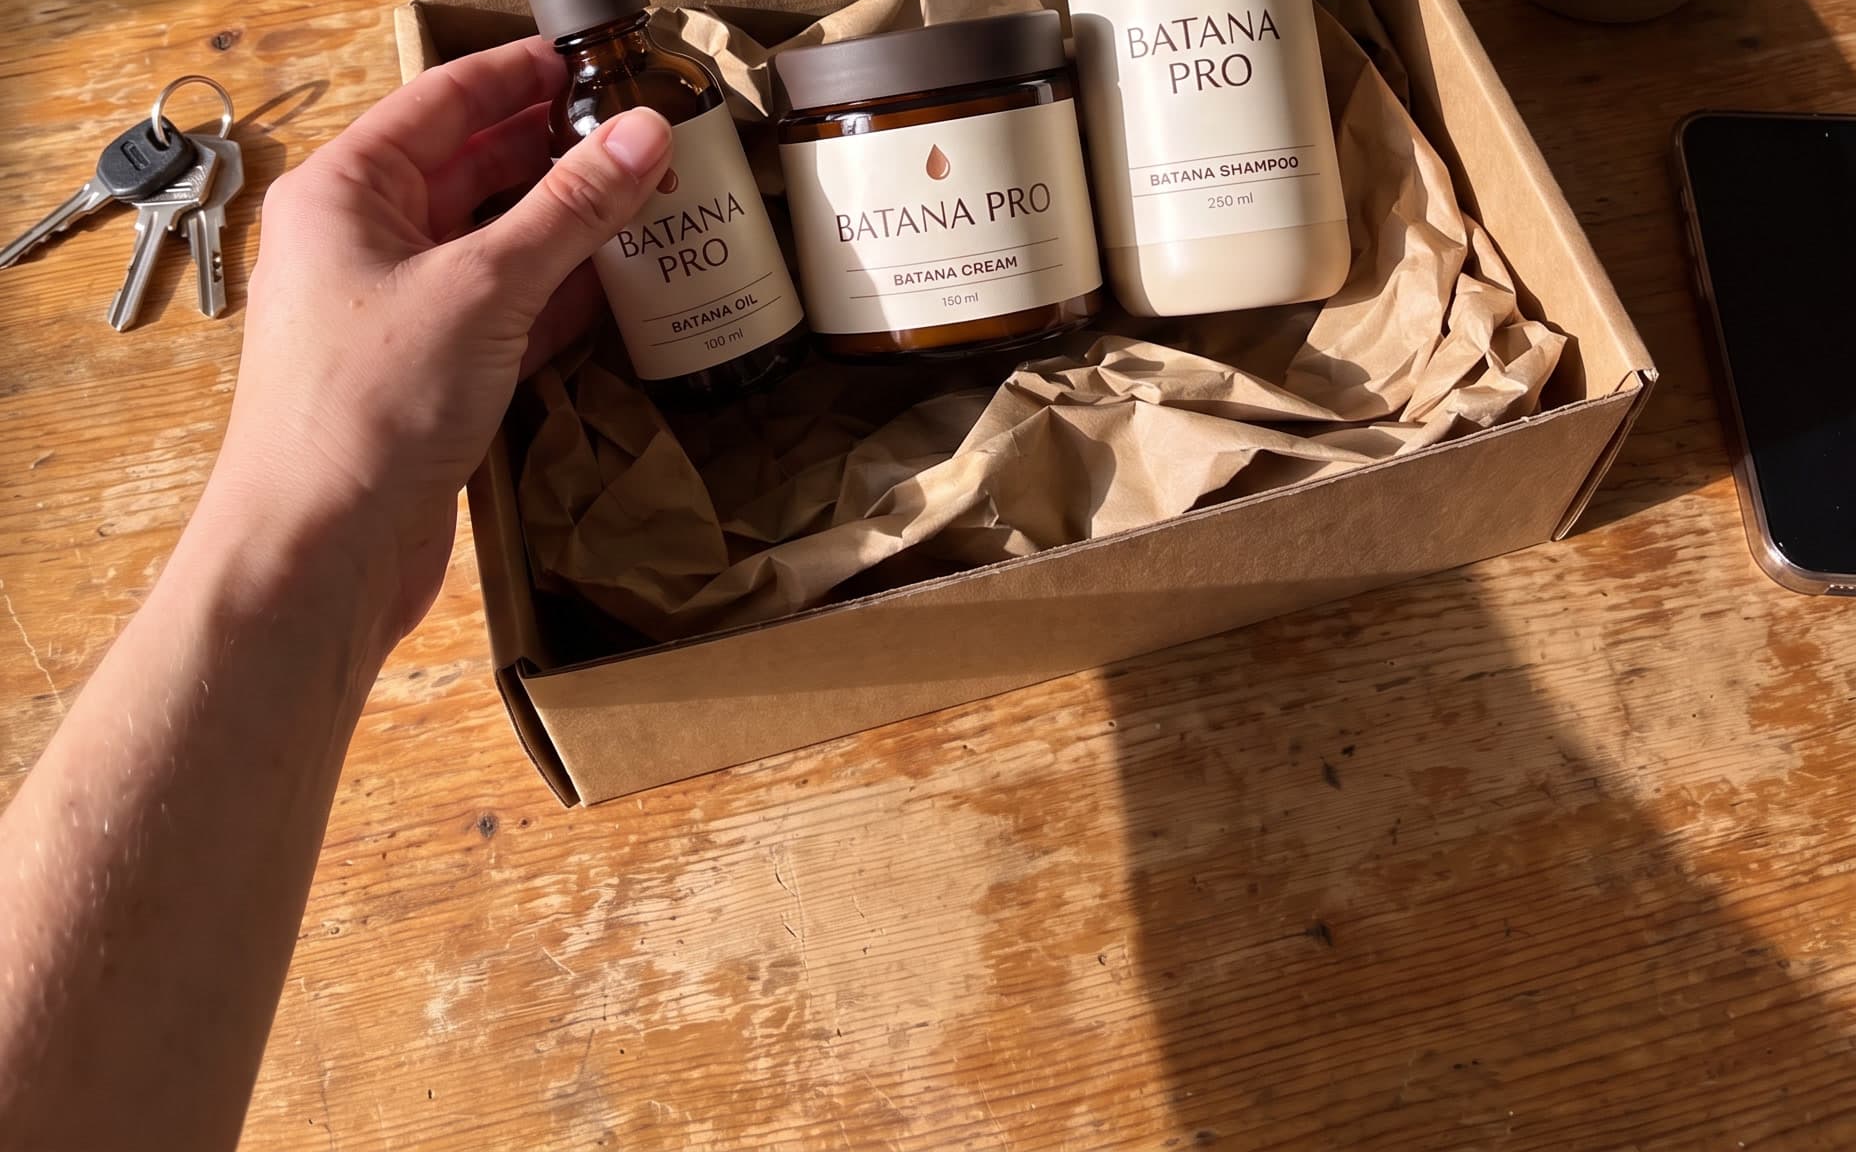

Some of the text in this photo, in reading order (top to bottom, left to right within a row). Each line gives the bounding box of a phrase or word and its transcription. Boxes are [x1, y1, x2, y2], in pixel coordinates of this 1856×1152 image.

[1127, 8, 1280, 59] BATANA
[1169, 53, 1252, 94] PRO
[1150, 156, 1299, 187] BATANA SHAMPOO
[835, 182, 1051, 243] BATANA PRO
[1207, 192, 1254, 209] 250 ml
[617, 192, 745, 258] BATANA
[657, 237, 729, 284] PRO
[893, 256, 1018, 287] BATANA CREAM
[671, 294, 758, 334] BATANA OIL
[941, 291, 979, 308] 150 ml
[703, 328, 744, 351] 100 ml
